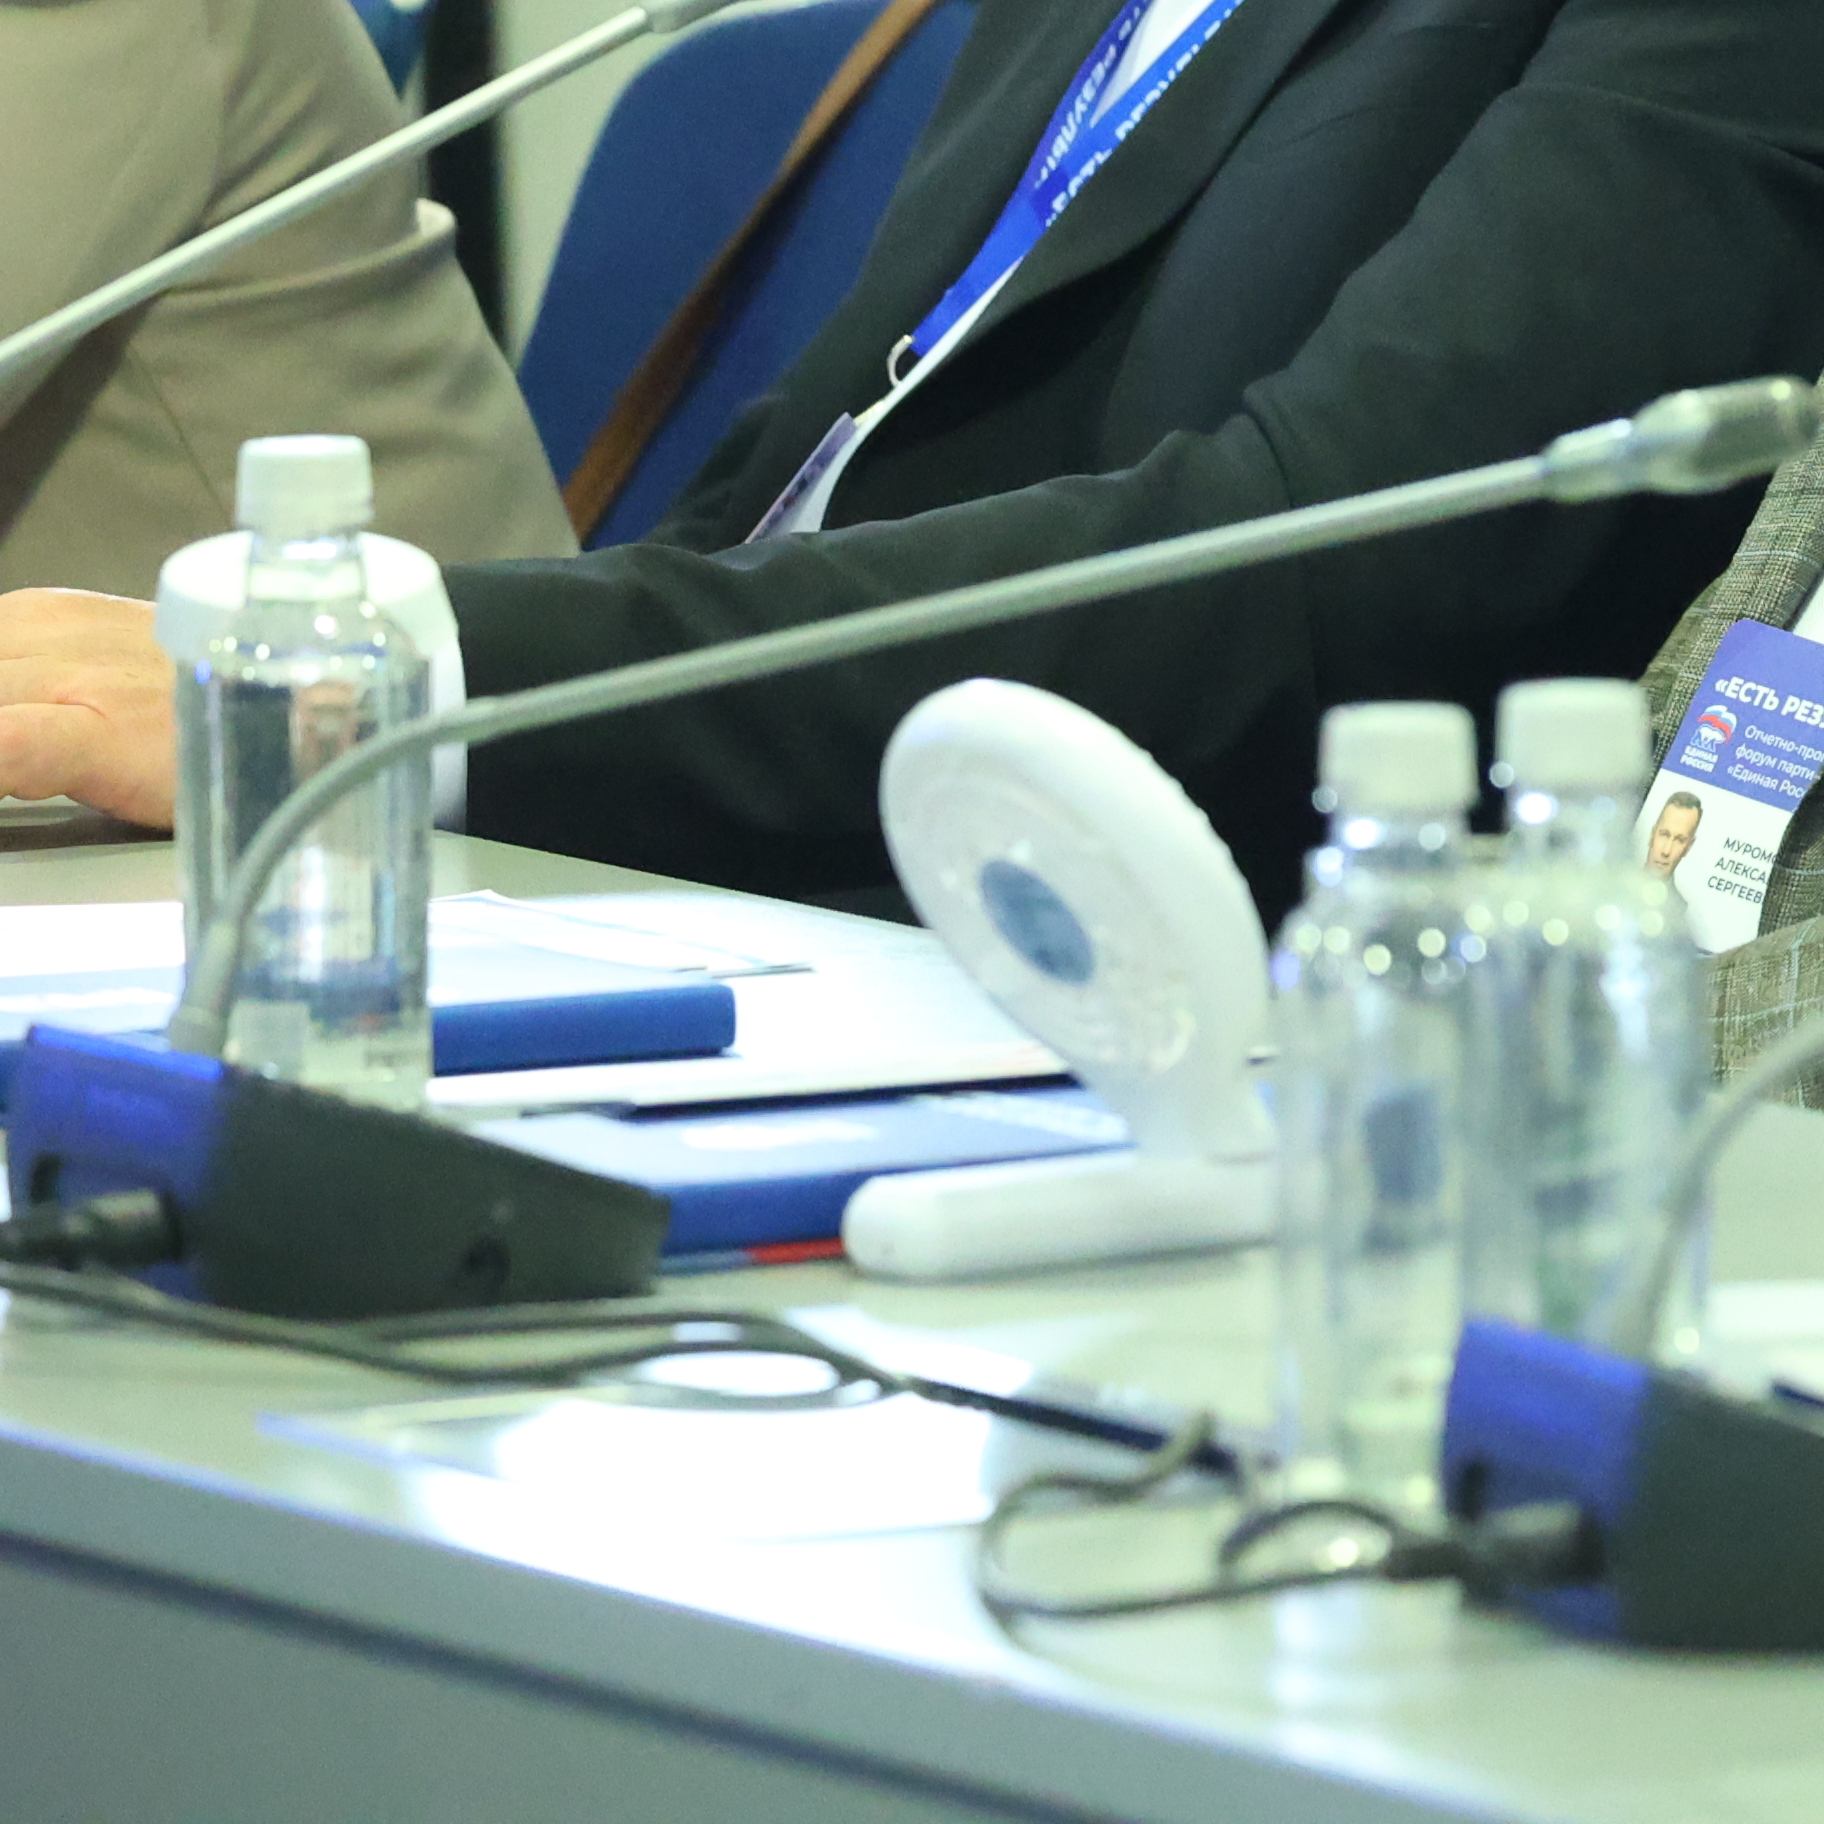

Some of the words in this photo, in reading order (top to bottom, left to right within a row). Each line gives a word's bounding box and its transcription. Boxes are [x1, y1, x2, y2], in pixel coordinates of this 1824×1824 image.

[1714, 676, 1780, 711] «ЕСТЬ
[1680, 755, 1715, 773] РОССИЯ
[1735, 743, 1779, 769] форум
[1727, 764, 1777, 791] «Единая
[1707, 875, 1763, 904] СЕРГЕЕВ
